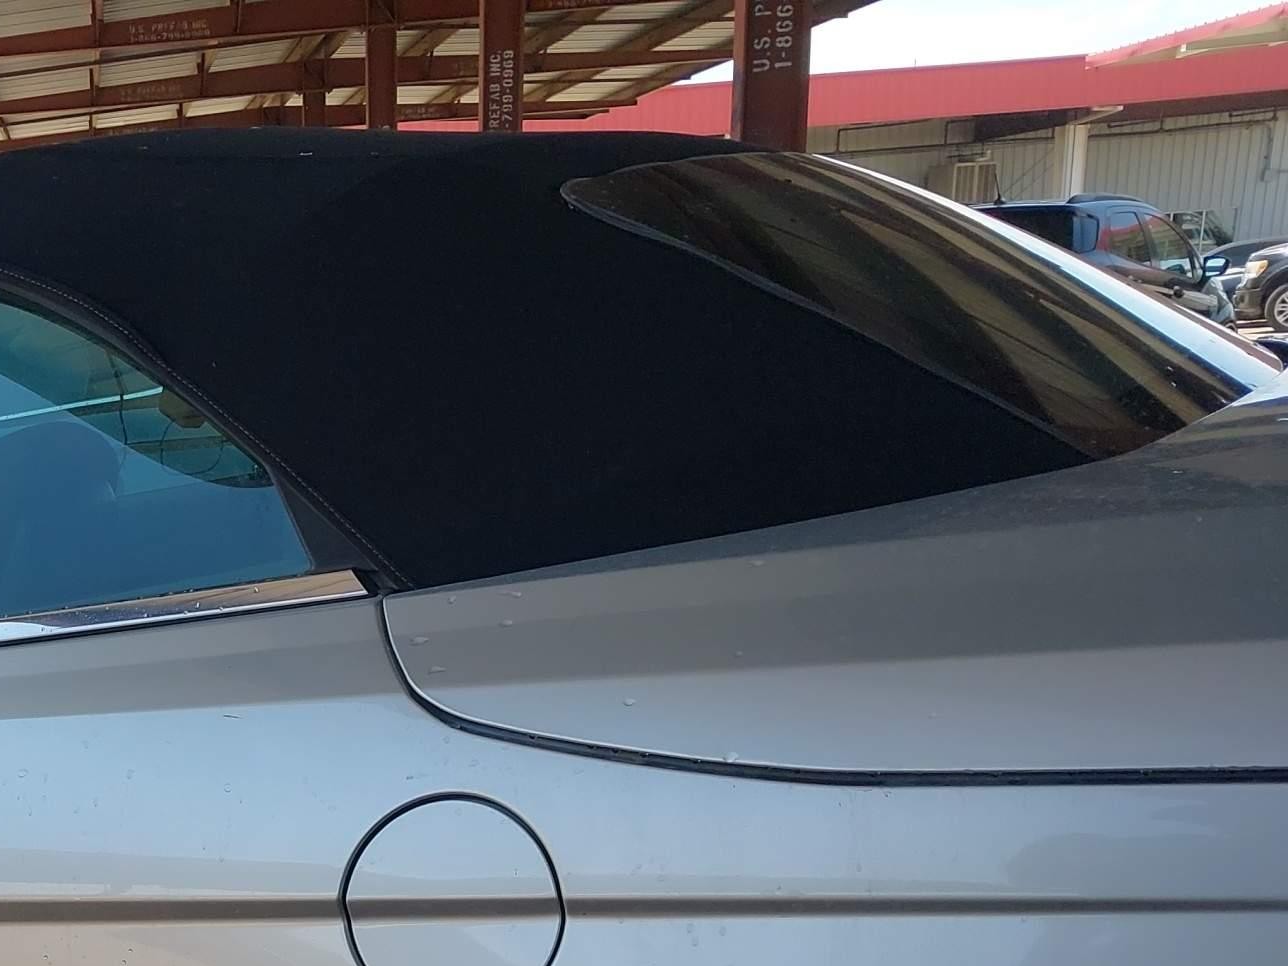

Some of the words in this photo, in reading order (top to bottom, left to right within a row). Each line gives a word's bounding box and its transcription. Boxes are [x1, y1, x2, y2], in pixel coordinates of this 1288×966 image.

[753, 0, 772, 17] P
[752, 29, 771, 73] U.S.
[488, 83, 501, 131] REFAB
